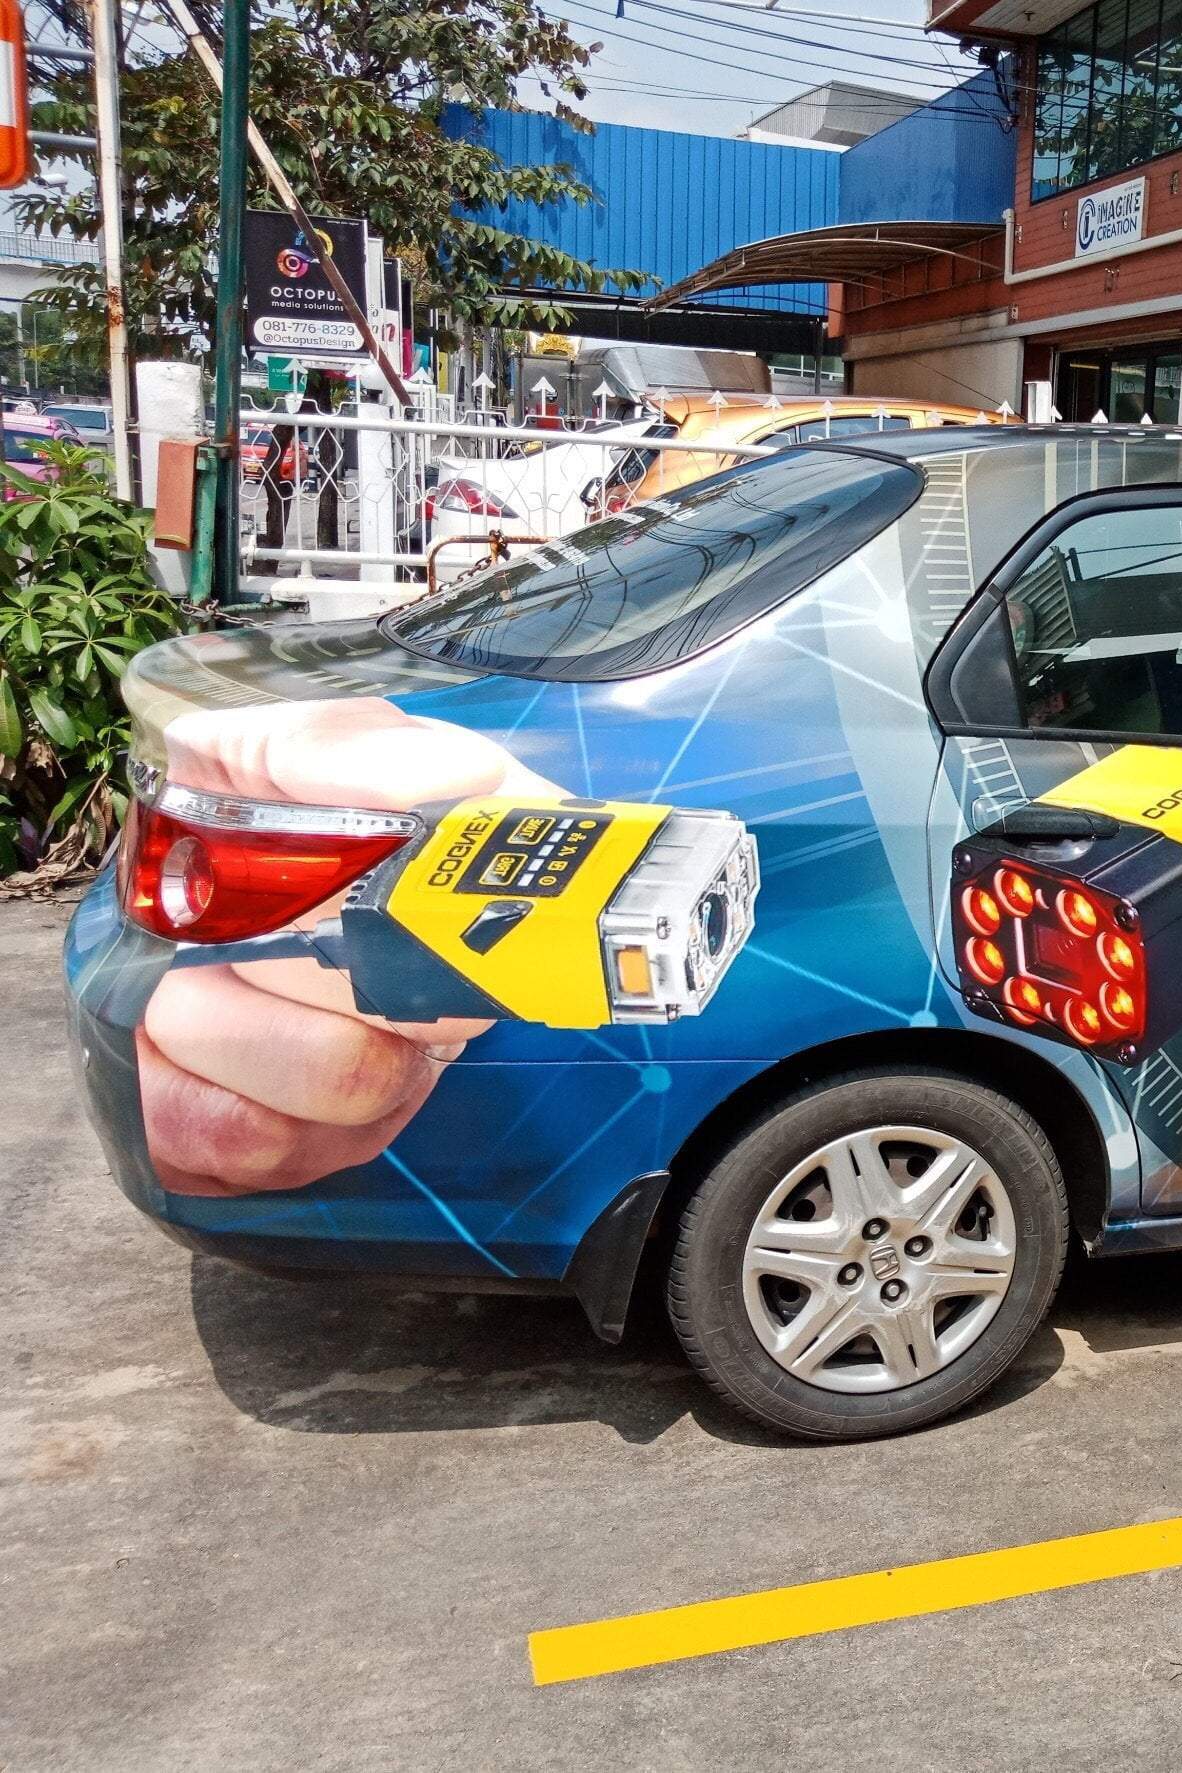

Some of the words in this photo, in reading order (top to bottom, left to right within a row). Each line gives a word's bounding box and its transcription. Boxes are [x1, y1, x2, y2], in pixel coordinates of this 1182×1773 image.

[1096, 215, 1138, 242] CREATION
[271, 299, 301, 310] media
[303, 301, 345, 312] solutions
[262, 319, 355, 336] 081-776-8329
[263, 333, 356, 349] @OctopusDesign
